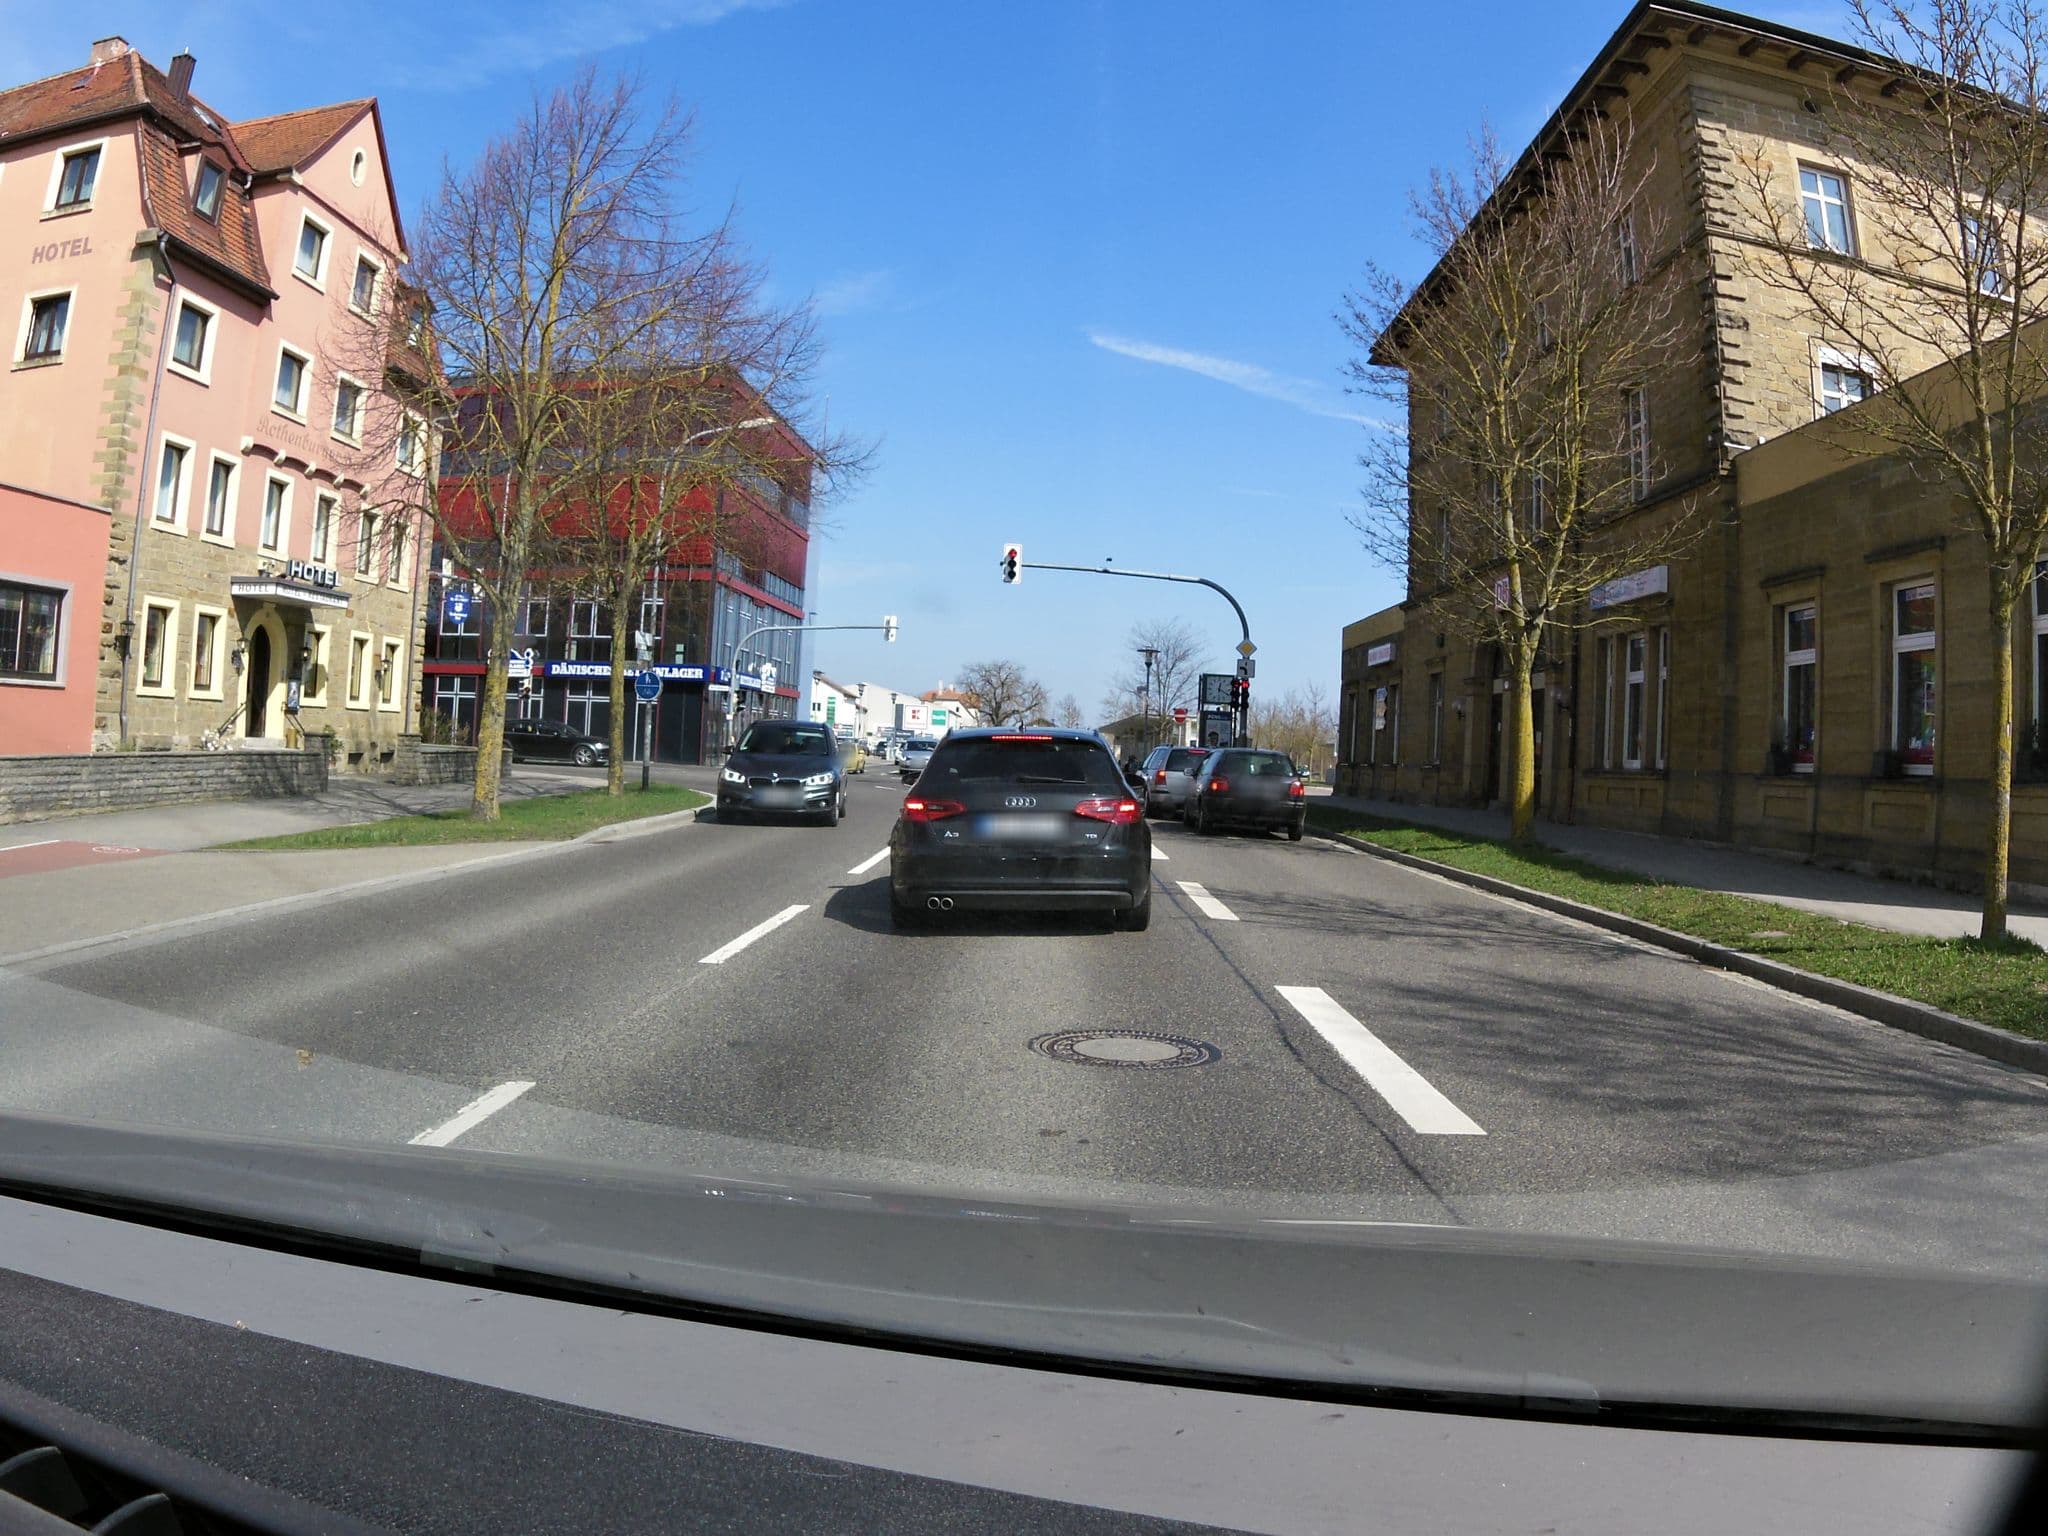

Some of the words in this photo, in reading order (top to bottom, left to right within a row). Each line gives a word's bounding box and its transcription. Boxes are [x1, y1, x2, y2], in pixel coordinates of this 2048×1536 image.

[31, 236, 93, 264] HOTEL
[290, 559, 342, 587] HOTEL
[238, 583, 270, 593] HOTEL
[551, 663, 613, 676] DÄNISCHE
[623, 667, 704, 679] NLAGER
